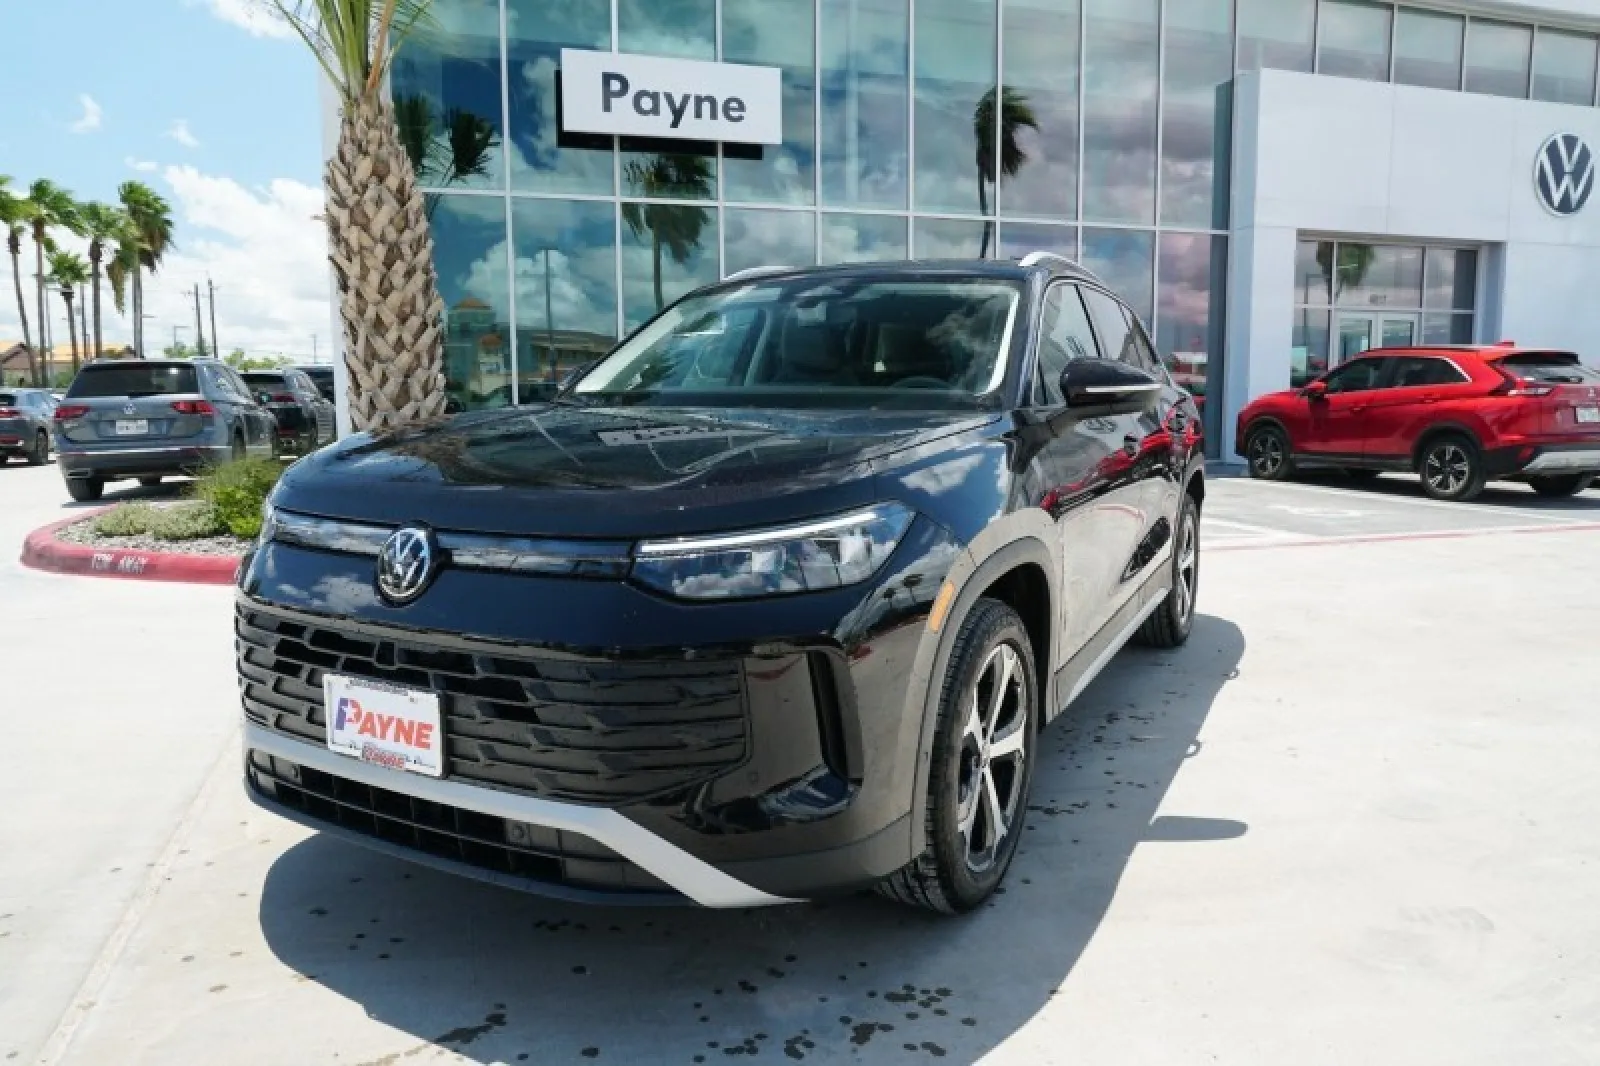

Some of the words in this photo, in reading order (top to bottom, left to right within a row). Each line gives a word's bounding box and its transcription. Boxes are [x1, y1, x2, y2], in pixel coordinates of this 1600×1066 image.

[601, 71, 747, 129] Payne
[1534, 132, 1594, 216] VW
[335, 697, 433, 750] PAYNE
